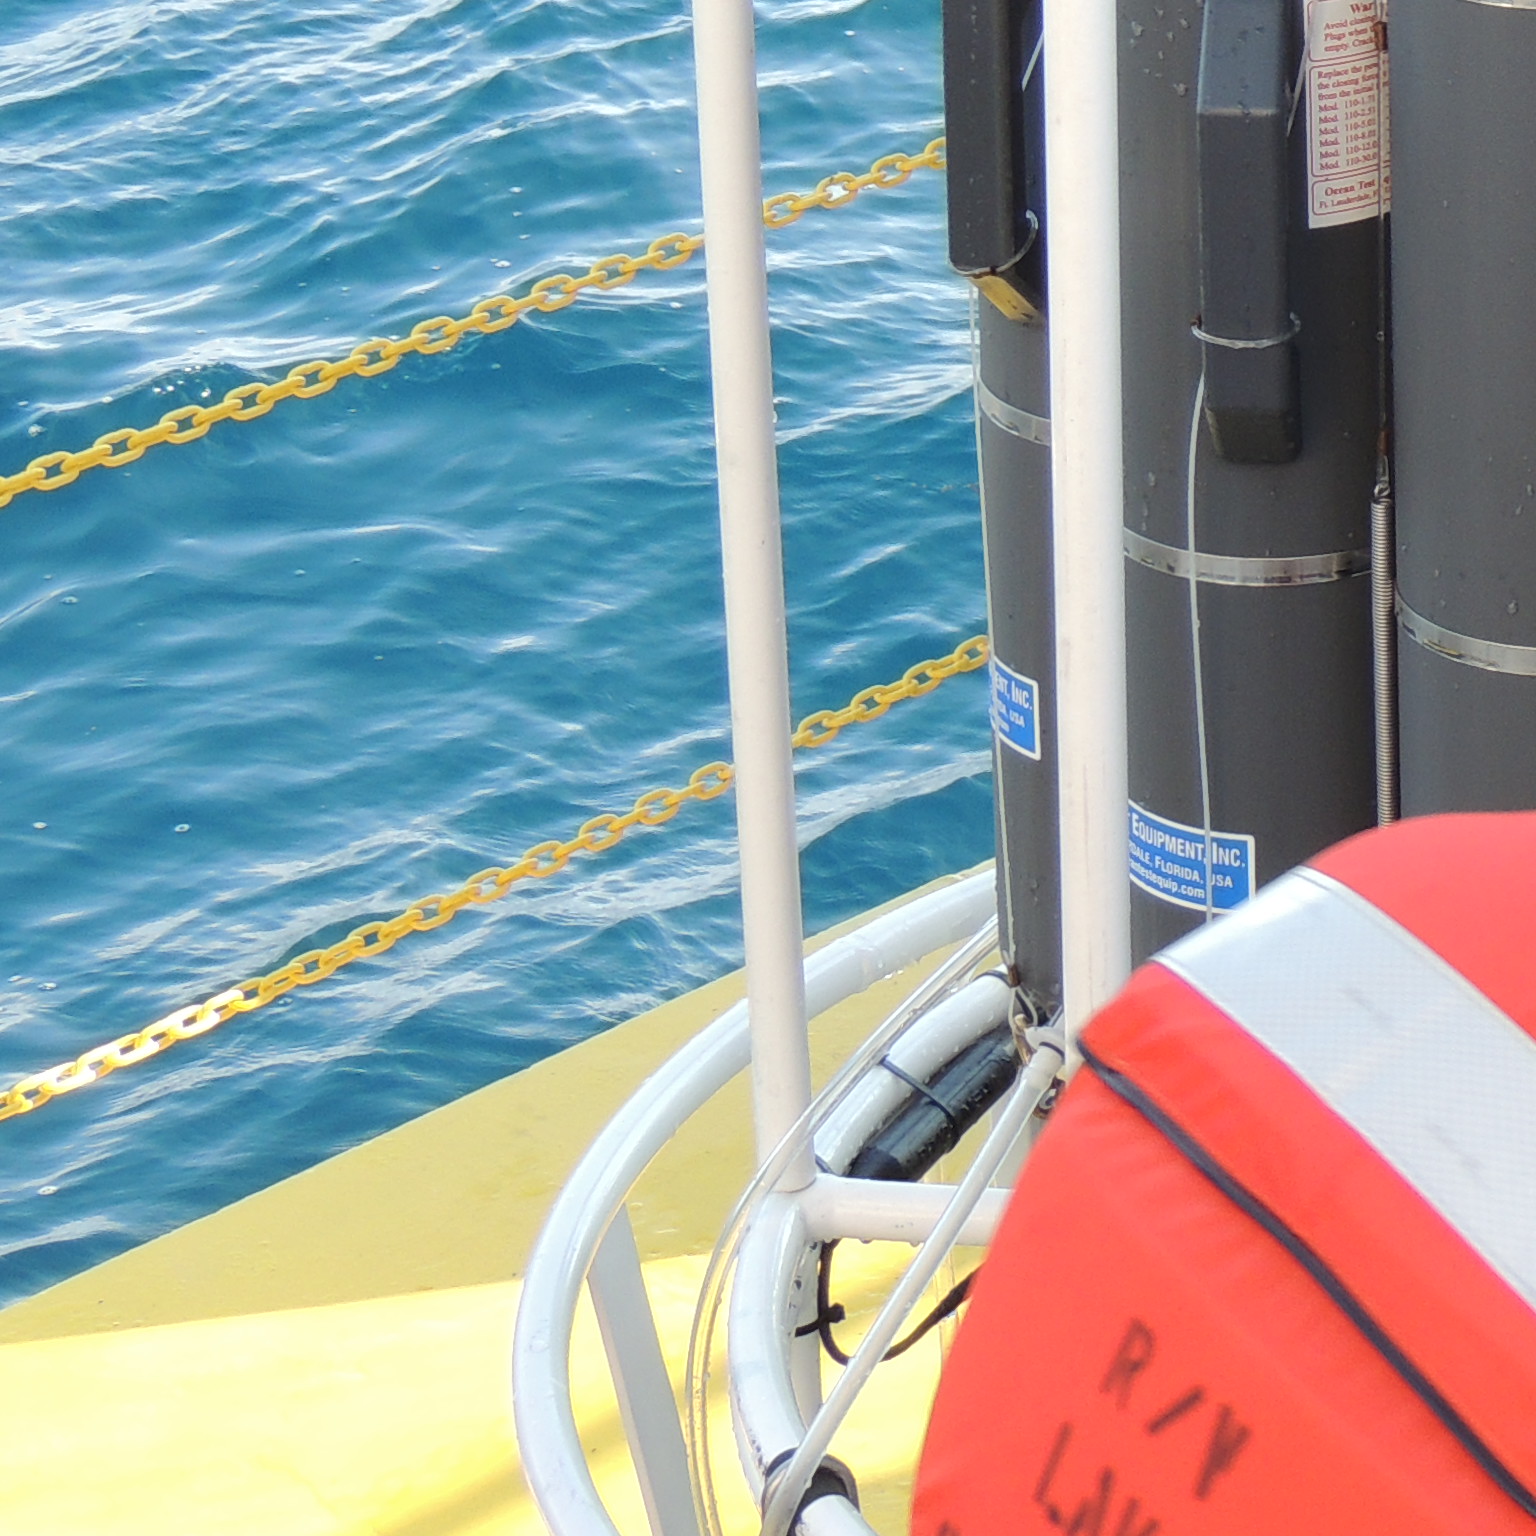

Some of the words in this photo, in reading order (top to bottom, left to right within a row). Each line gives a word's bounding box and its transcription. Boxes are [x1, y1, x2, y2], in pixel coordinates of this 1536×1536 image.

[1011, 680, 1033, 711] INC.
[1155, 854, 1204, 885] FLORIDA,
[1212, 842, 1246, 868] INC.
